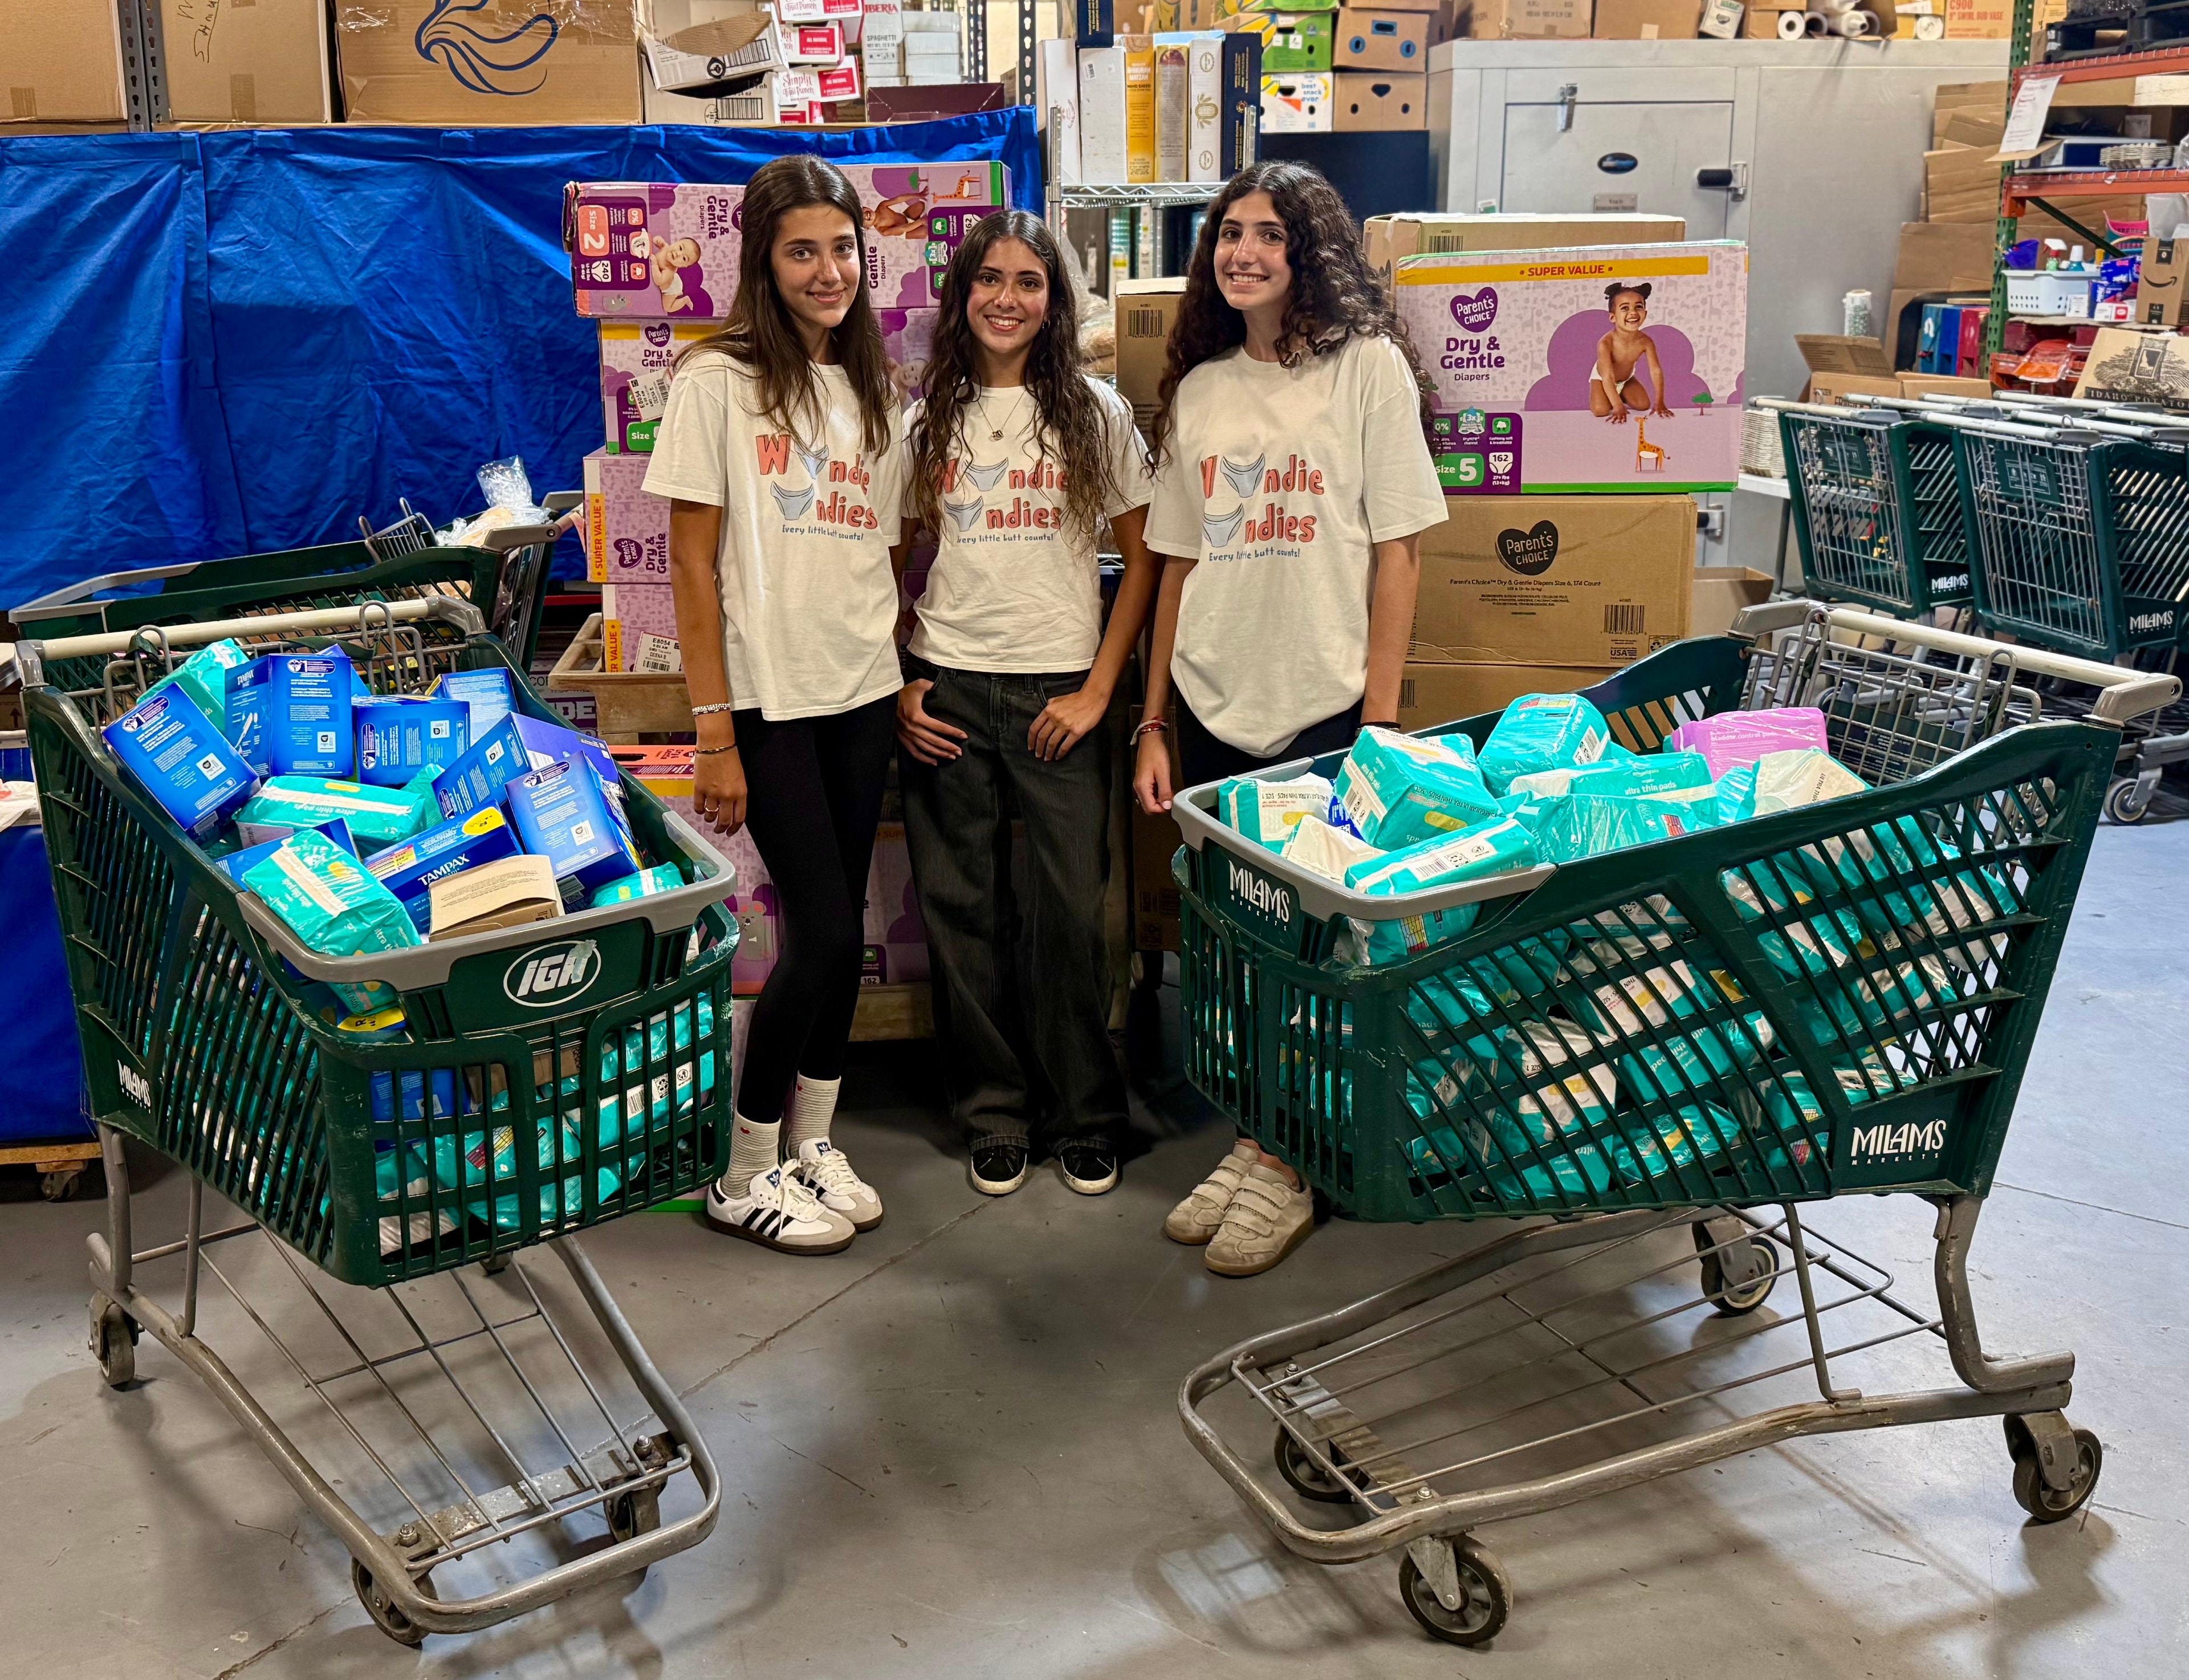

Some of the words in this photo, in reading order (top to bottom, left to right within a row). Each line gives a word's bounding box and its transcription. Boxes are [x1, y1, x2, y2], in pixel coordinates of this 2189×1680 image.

[865, 4, 898, 14] IBERIA
[1958, 11, 1975, 20] SWIRL
[1976, 11, 1988, 20] BUD
[1989, 11, 2003, 20] VASE
[783, 74, 812, 89] Simply
[631, 210, 638, 223] 0%
[707, 195, 717, 240] Gentle
[717, 198, 729, 223] Dry
[719, 227, 730, 237] &
[583, 233, 605, 250] 2
[867, 246, 878, 289] Gentle
[1528, 266, 1565, 276] SUPER
[1568, 265, 1605, 275] VALUE
[1456, 295, 1494, 316] Parent's
[1464, 312, 1491, 325] CHOICE
[1446, 337, 1480, 355] Dry
[1486, 336, 1500, 351] &
[644, 349, 663, 359] Dry
[1440, 353, 1505, 369] Gentle
[1454, 373, 1490, 382] Diapers
[2090, 390, 2128, 401] IDAHO
[1435, 422, 1449, 431] 0%
[1435, 465, 1455, 474] Size
[1459, 458, 1477, 482] 5
[783, 524, 805, 534] Every
[808, 526, 827, 535] little
[827, 529, 837, 538] butt
[645, 536, 655, 545] &
[1506, 531, 1554, 555] Parent's
[594, 539, 603, 569] SUPER
[621, 540, 633, 565] Parent's
[657, 533, 667, 575] Gentle
[1209, 552, 1234, 562] Every
[1236, 550, 1252, 560] little
[1255, 546, 1275, 558] butt
[1277, 548, 1300, 558] counts!
[1516, 550, 1549, 566] CHOICE
[646, 552, 657, 571] Dry
[1711, 733, 1736, 742] bladder
[1428, 790, 1442, 800] PADS
[1625, 787, 1641, 796] ultra
[1641, 784, 1658, 793] thin
[1659, 781, 1677, 791] pads
[1441, 794, 1454, 804] THIN
[1454, 800, 1470, 810] ULTRA
[1469, 804, 1491, 817] REGULAR
[418, 853, 470, 886] TAMPAX
[1852, 1153, 1939, 1166] MARKETS
